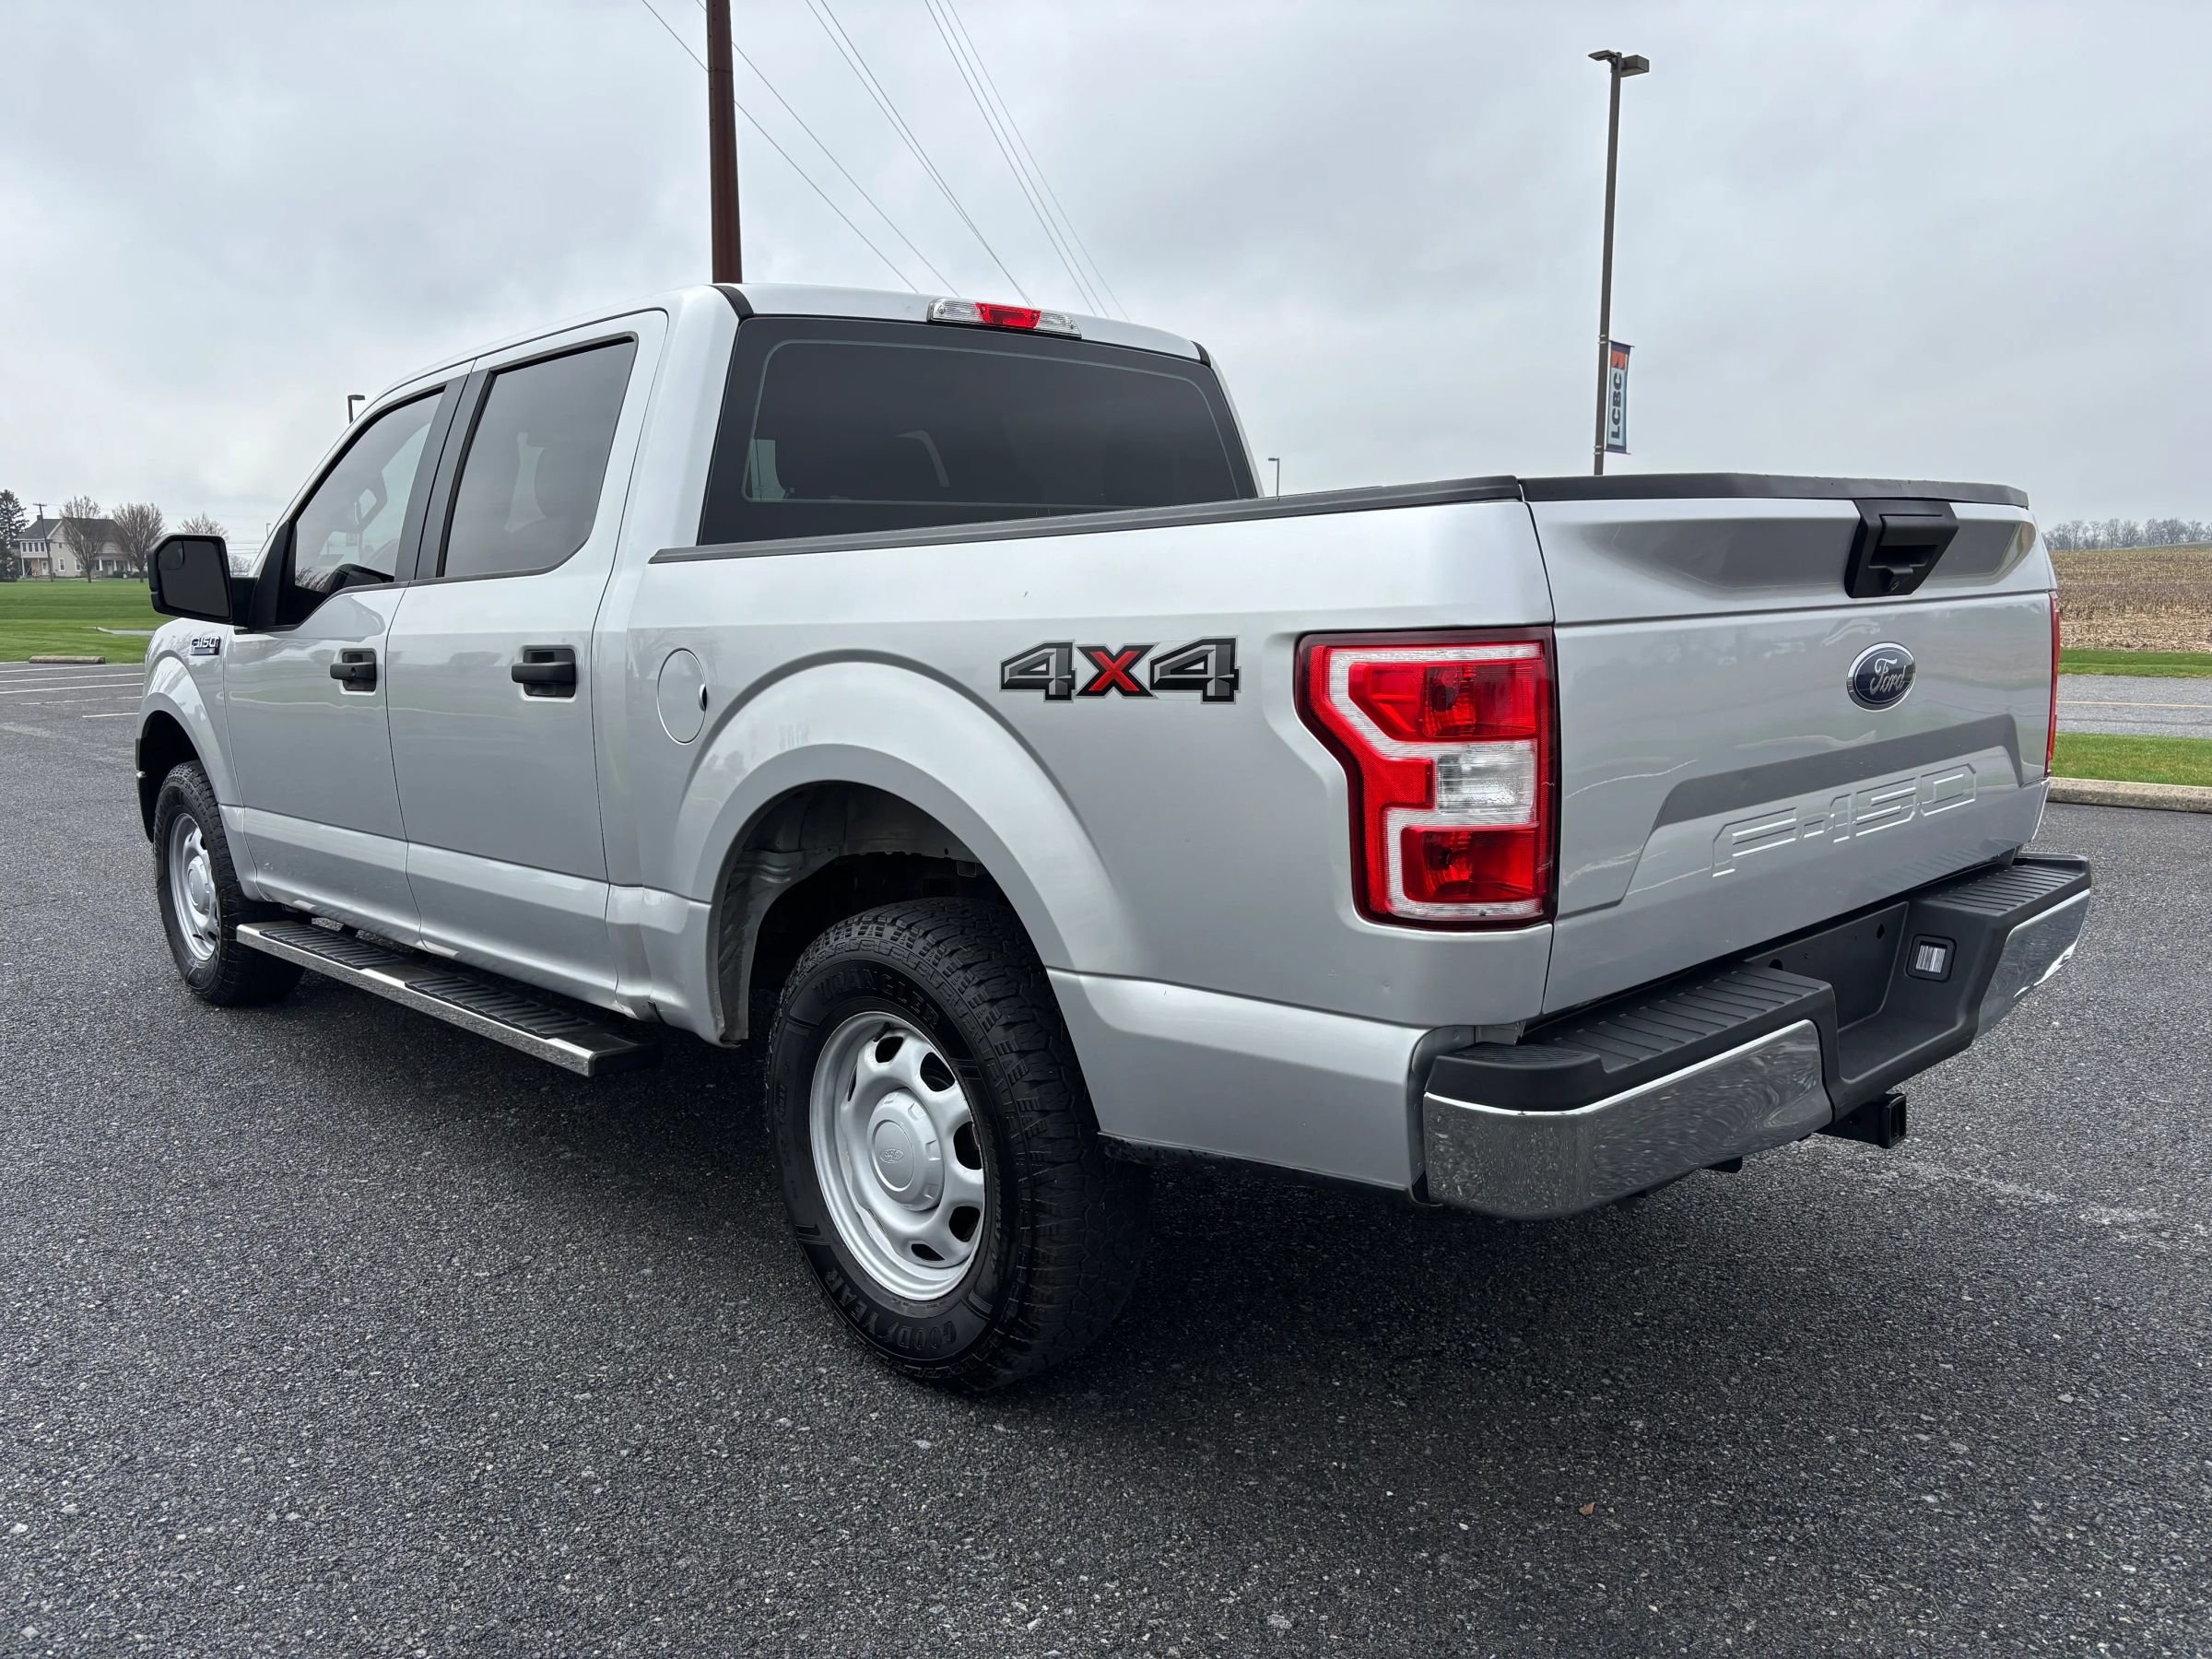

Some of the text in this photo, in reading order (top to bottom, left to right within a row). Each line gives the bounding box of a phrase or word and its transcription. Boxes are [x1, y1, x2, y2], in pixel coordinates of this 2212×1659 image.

[1611, 371, 1622, 439] LCBC
[1869, 658, 1907, 695] Ford
[1712, 763, 1977, 877] F-150
[815, 969, 940, 1029] WRANGLER
